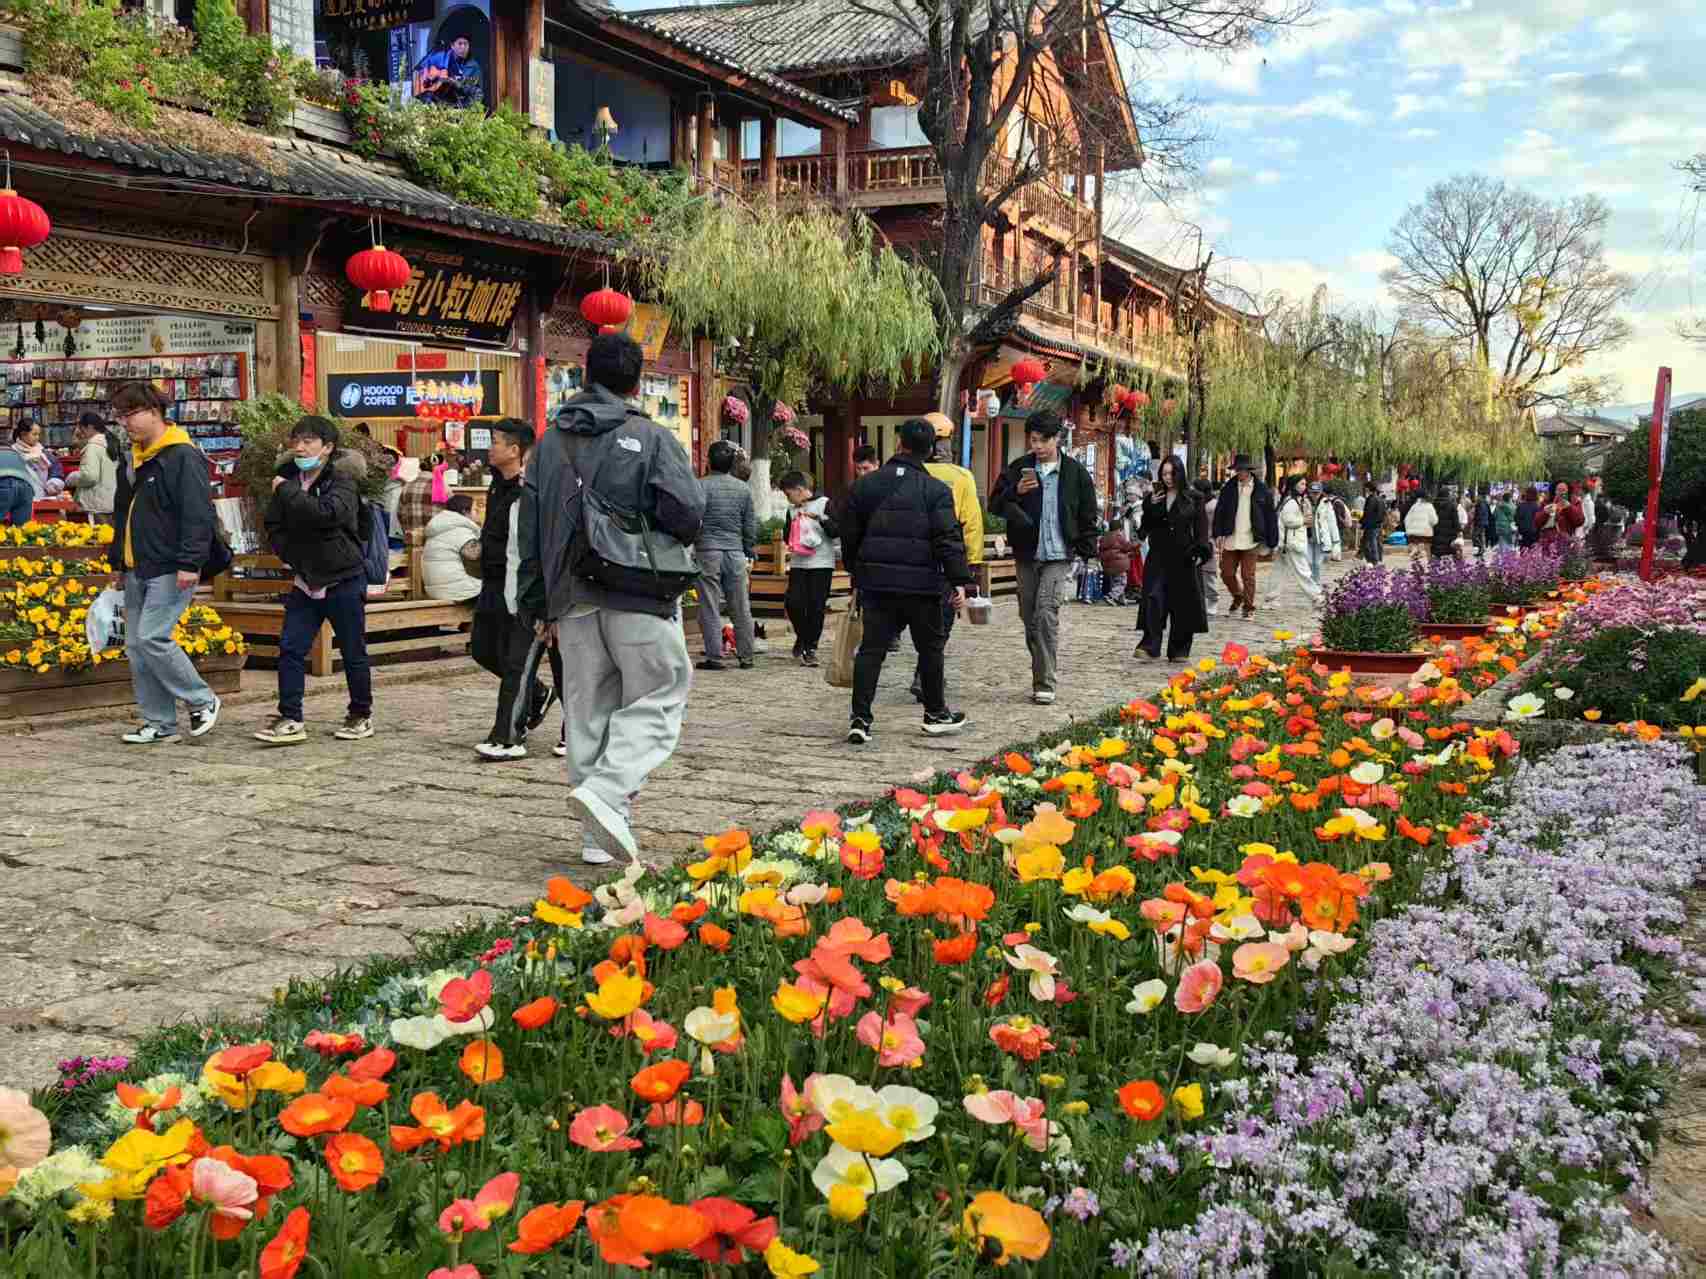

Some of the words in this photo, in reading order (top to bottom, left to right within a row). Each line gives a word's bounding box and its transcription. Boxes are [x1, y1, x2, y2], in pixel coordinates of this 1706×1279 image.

[361, 266, 522, 327] 南小粒咖啡
[434, 325, 470, 338] COFFEE
[363, 385, 403, 396] HOGOOD
[363, 396, 397, 406] COFFEE
